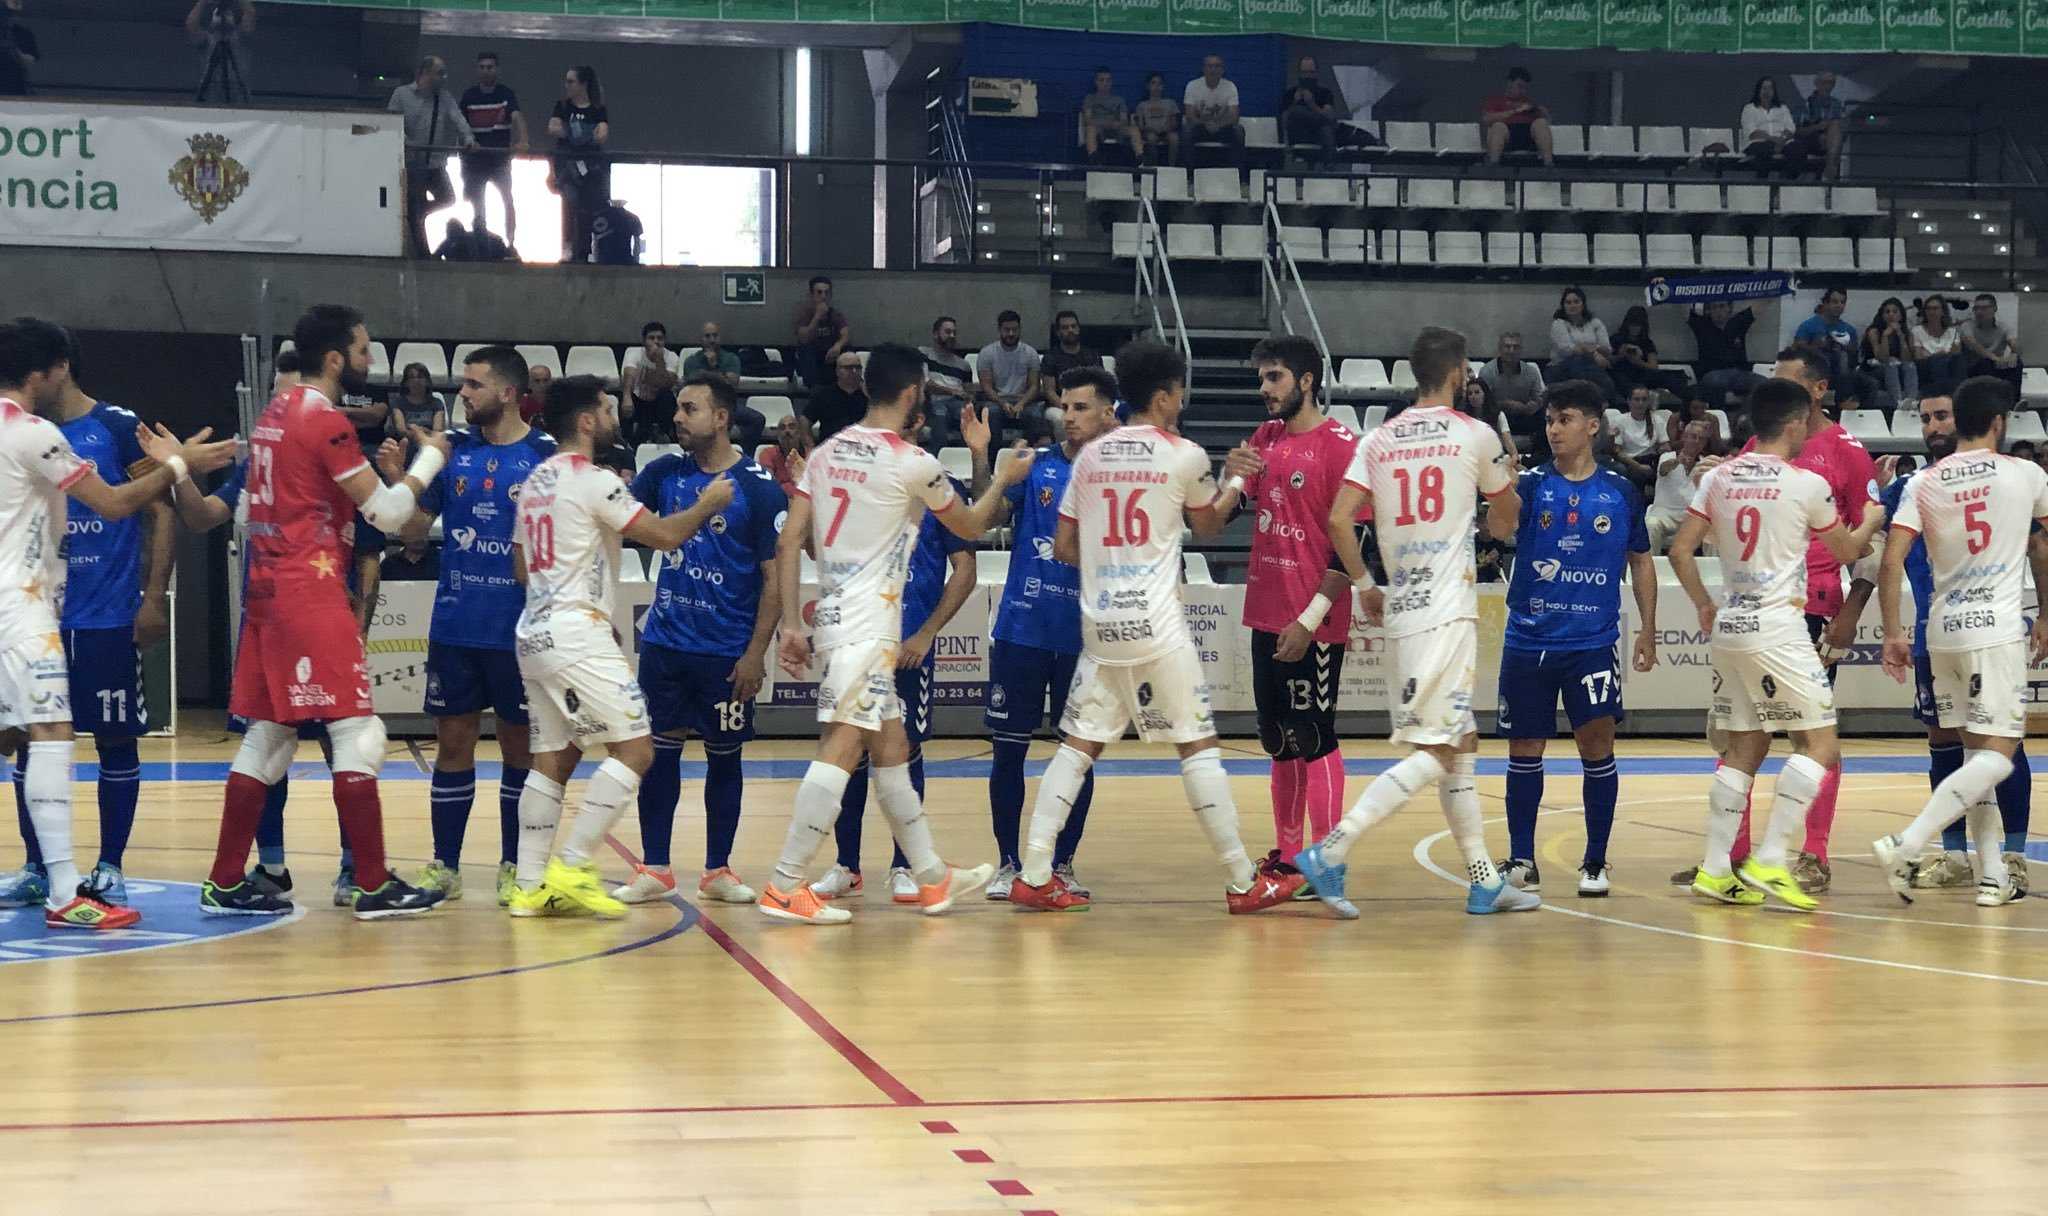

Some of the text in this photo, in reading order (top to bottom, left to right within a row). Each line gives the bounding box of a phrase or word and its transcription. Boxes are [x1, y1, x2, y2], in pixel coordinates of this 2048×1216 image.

[0, 170, 118, 210] ncia
[1393, 465, 1445, 526] 18
[1955, 485, 1991, 503] LLUC
[824, 486, 852, 547] 7
[1103, 489, 1150, 547] 16
[1965, 501, 1992, 555] 5
[476, 540, 512, 556] NOV
[524, 513, 554, 573] 10
[1736, 505, 1761, 562] 9
[1560, 570, 1607, 585] NOVO
[371, 613, 407, 626] COS
[1183, 604, 1229, 616] ERCIAL
[1545, 602, 1600, 613] NOU DENT
[936, 635, 980, 655] PINT
[934, 661, 981, 673] ORACIÓN
[950, 688, 964, 698] 23
[967, 688, 982, 698] 64
[1286, 679, 1312, 710] 13
[1581, 670, 1612, 705] 17
[96, 689, 126, 722] 11
[713, 700, 746, 731] 18
